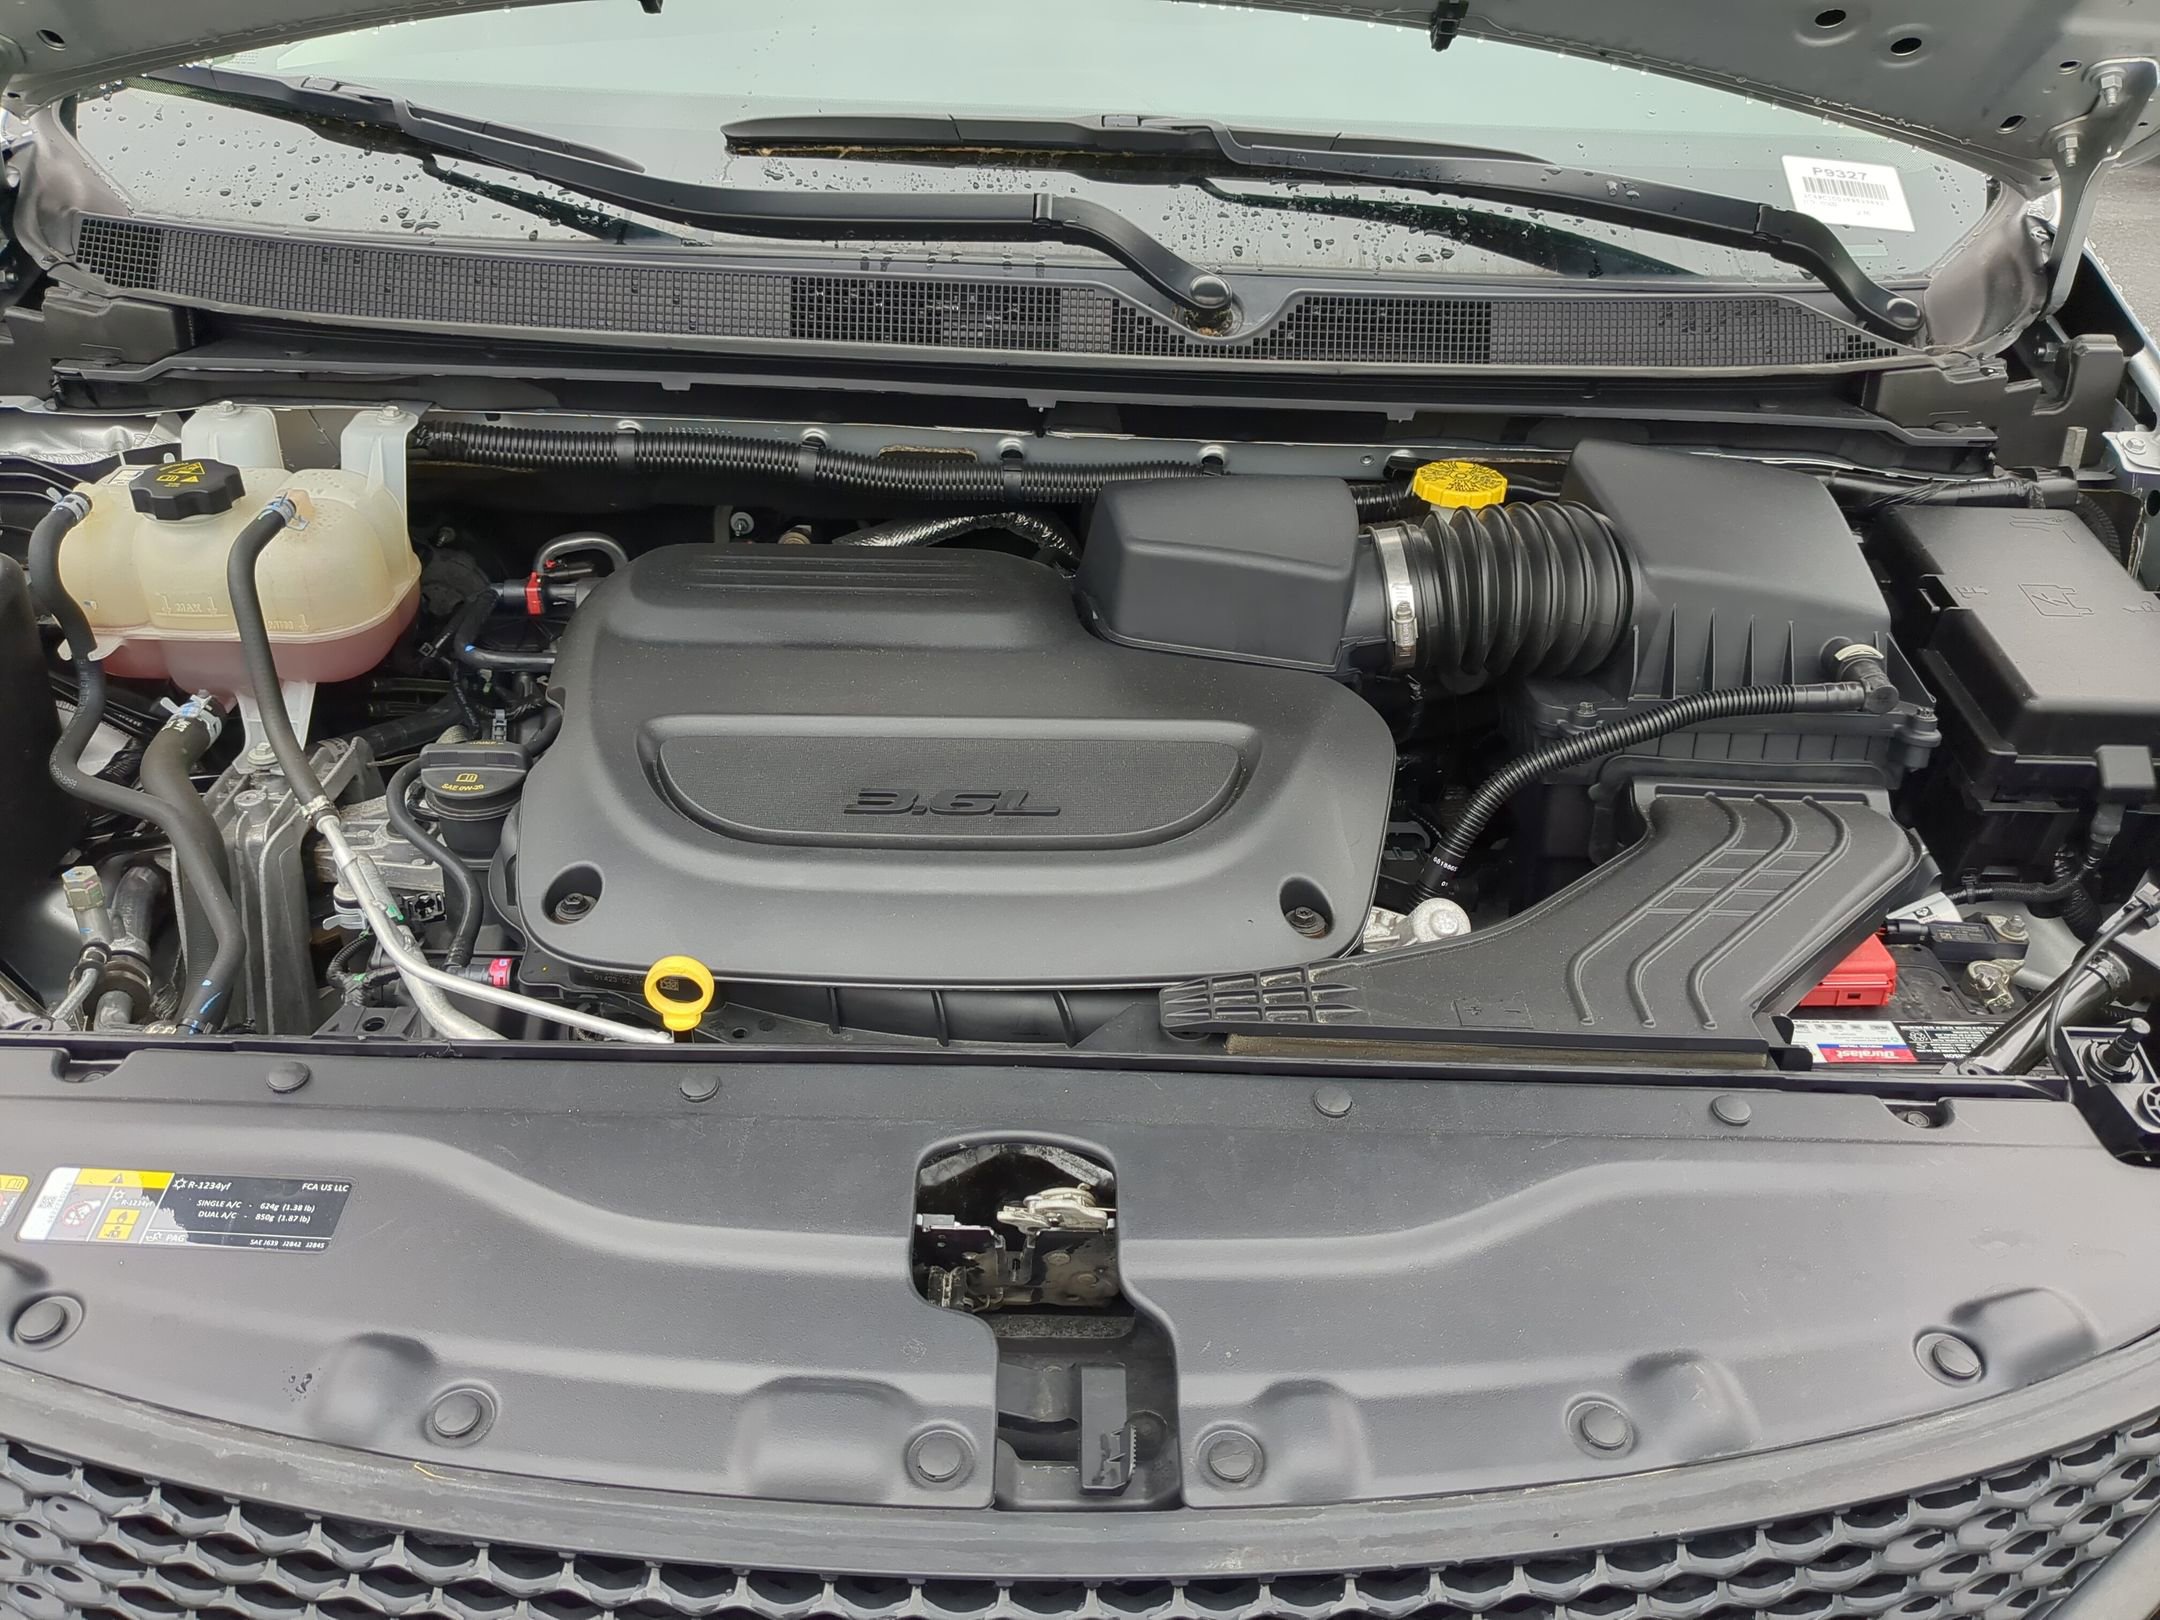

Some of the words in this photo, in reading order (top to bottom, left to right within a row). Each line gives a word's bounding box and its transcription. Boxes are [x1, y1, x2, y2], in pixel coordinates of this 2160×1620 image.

[1812, 167, 1867, 181] P9327
[441, 783, 458, 791] SAE
[843, 788, 1060, 816] 3.6L
[1836, 1049, 1900, 1059] Duralast
[187, 1182, 232, 1191] R-1234yf
[302, 1183, 318, 1191] FCA
[320, 1183, 332, 1191] US
[334, 1184, 349, 1192] LLC
[197, 1199, 224, 1208] SINGLE
[225, 1200, 242, 1209] A/C
[260, 1203, 279, 1212] 624g
[282, 1203, 303, 1212] (1.38
[303, 1204, 316, 1213] lb)
[198, 1210, 220, 1218] DUAL
[221, 1211, 237, 1219] A/C
[255, 1213, 274, 1222] 850g
[277, 1214, 299, 1223] (1.87
[299, 1214, 311, 1224] lb)
[166, 1234, 186, 1242] PAG
